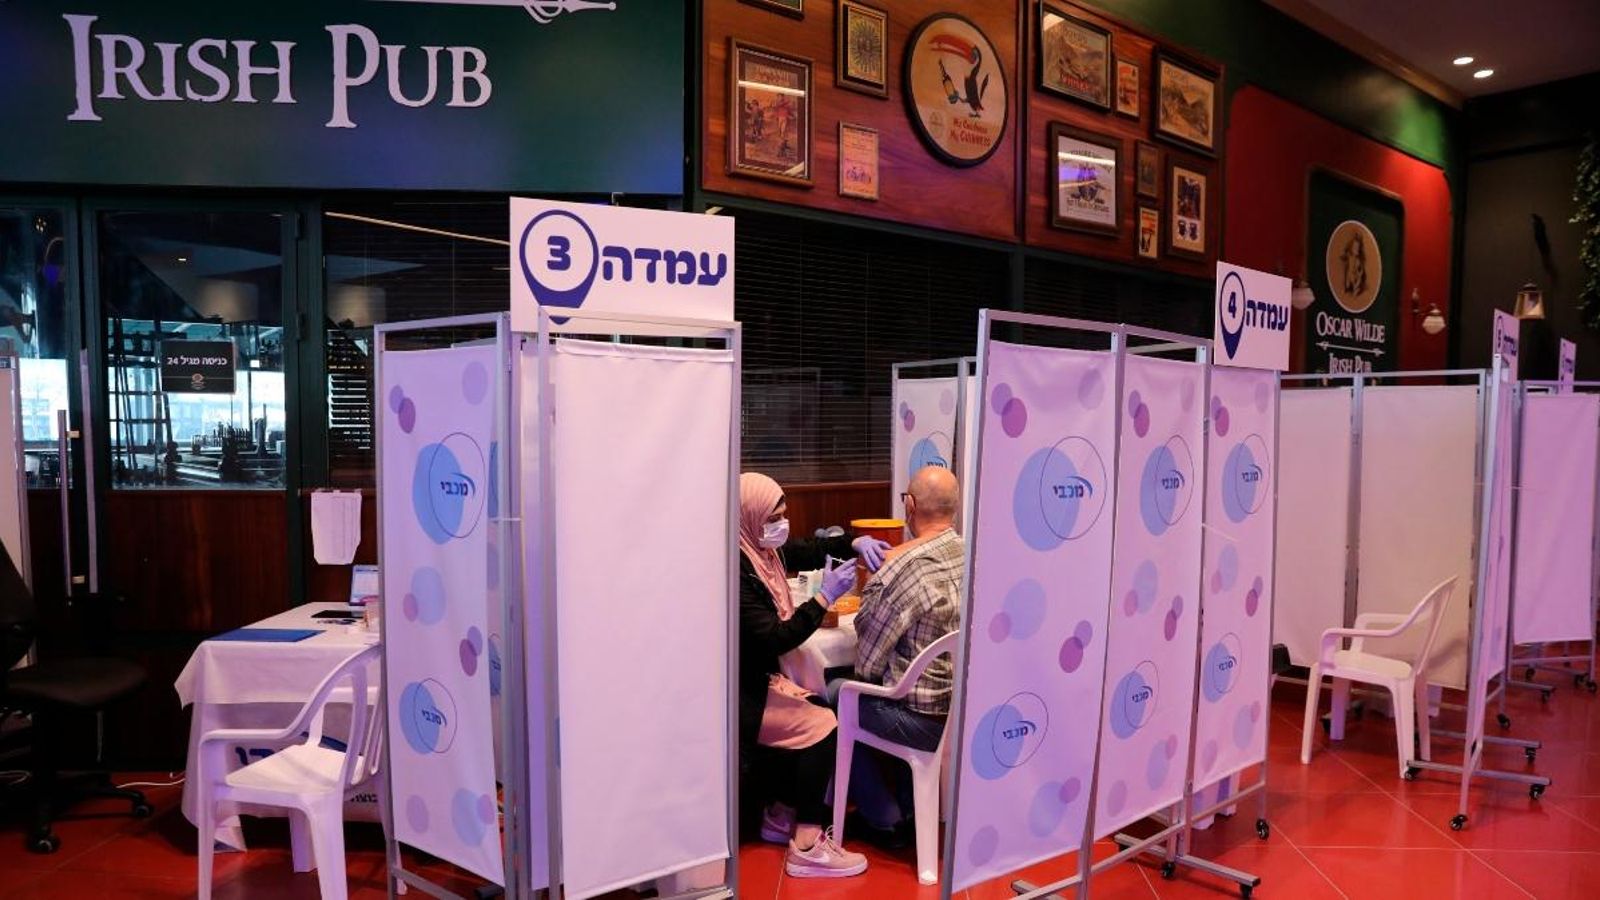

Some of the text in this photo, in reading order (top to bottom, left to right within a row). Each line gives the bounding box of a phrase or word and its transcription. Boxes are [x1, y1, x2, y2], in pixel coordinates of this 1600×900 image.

[62, 14, 493, 129] IRISH PUB
[547, 235, 728, 286] עמדה 3
[1227, 291, 1288, 331] עמדה 4
[1316, 311, 1385, 343] OSCAR WILDE
[167, 355, 228, 366] כניסה מגיל 24
[1329, 352, 1353, 374] IRISH
[1162, 477, 1180, 489] מכבי
[1242, 471, 1259, 482] מכבי
[440, 479, 468, 496] מכבי
[1053, 483, 1084, 499] מכבי
[1218, 660, 1234, 672] מכבי
[1132, 690, 1149, 703] מכבי
[421, 709, 442, 726] מכבי
[1003, 726, 1028, 739] מכבי
